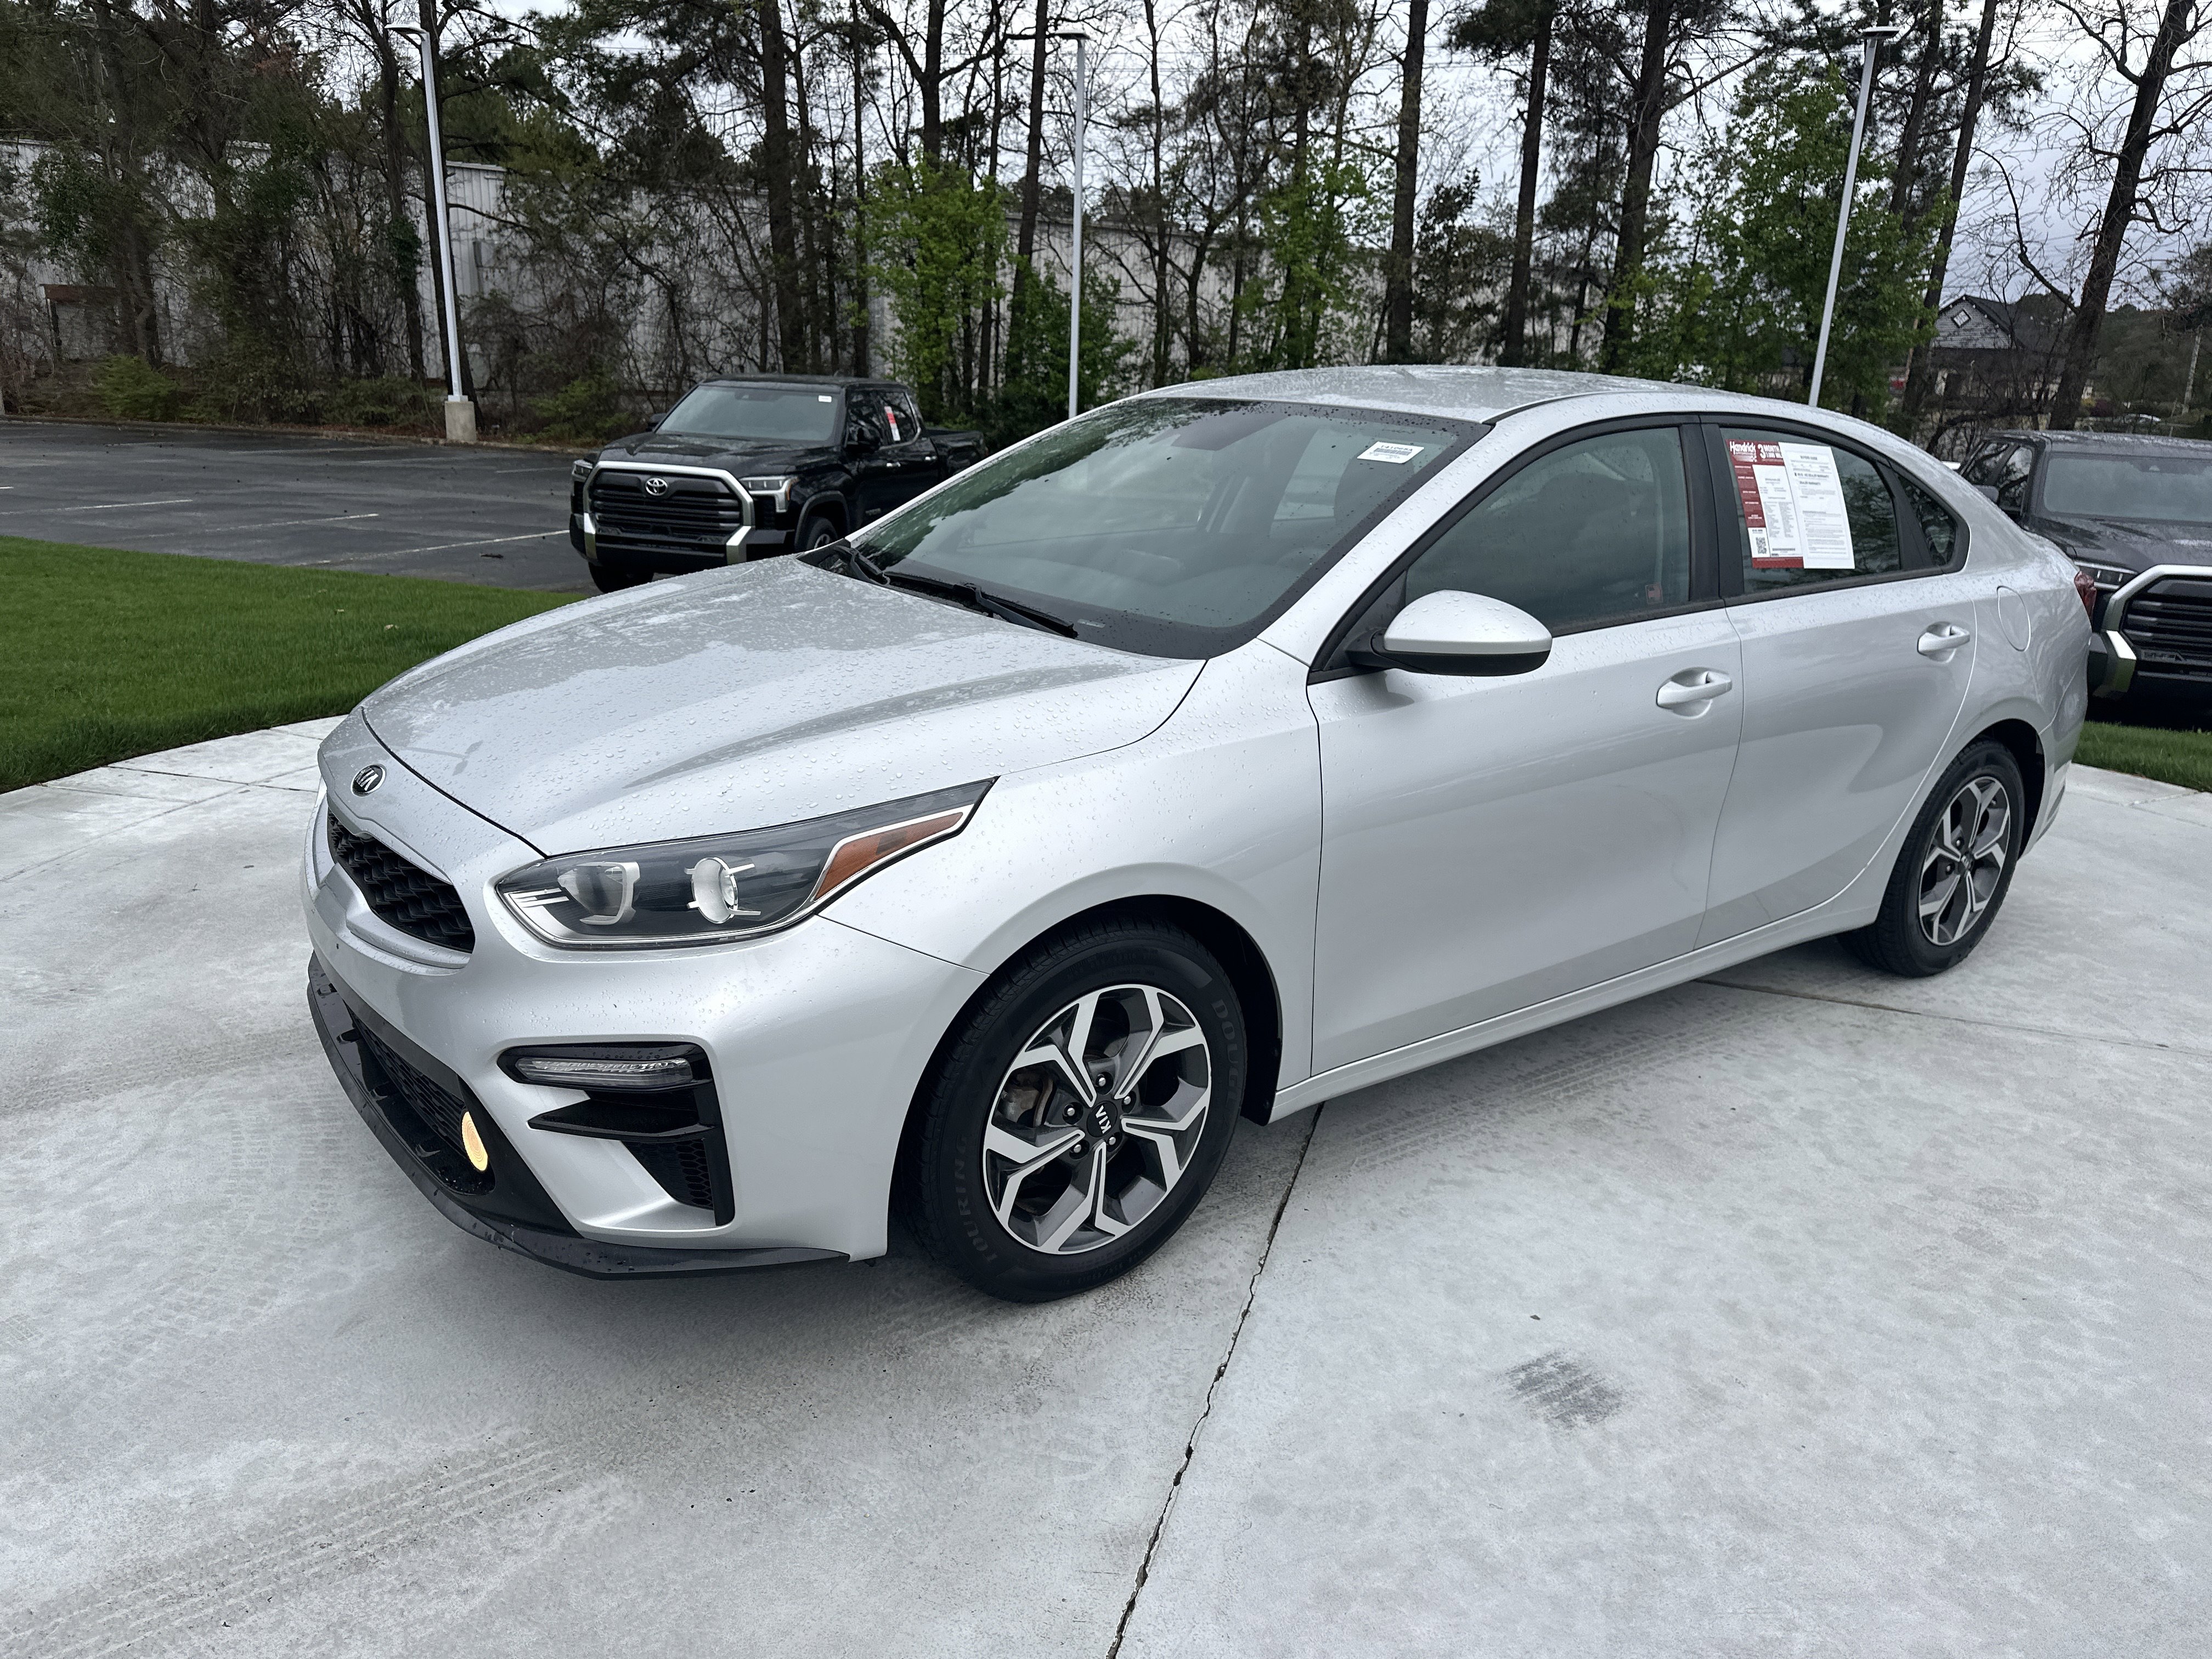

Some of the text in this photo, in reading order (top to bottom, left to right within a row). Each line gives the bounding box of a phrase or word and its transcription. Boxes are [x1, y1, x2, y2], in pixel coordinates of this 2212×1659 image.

[1729, 441, 1756, 455] Hendrick
[1757, 444, 1766, 459] 3
[355, 768, 379, 791] KIA
[1096, 1105, 1111, 1133] KIA
[954, 1134, 997, 1262] TOURING
